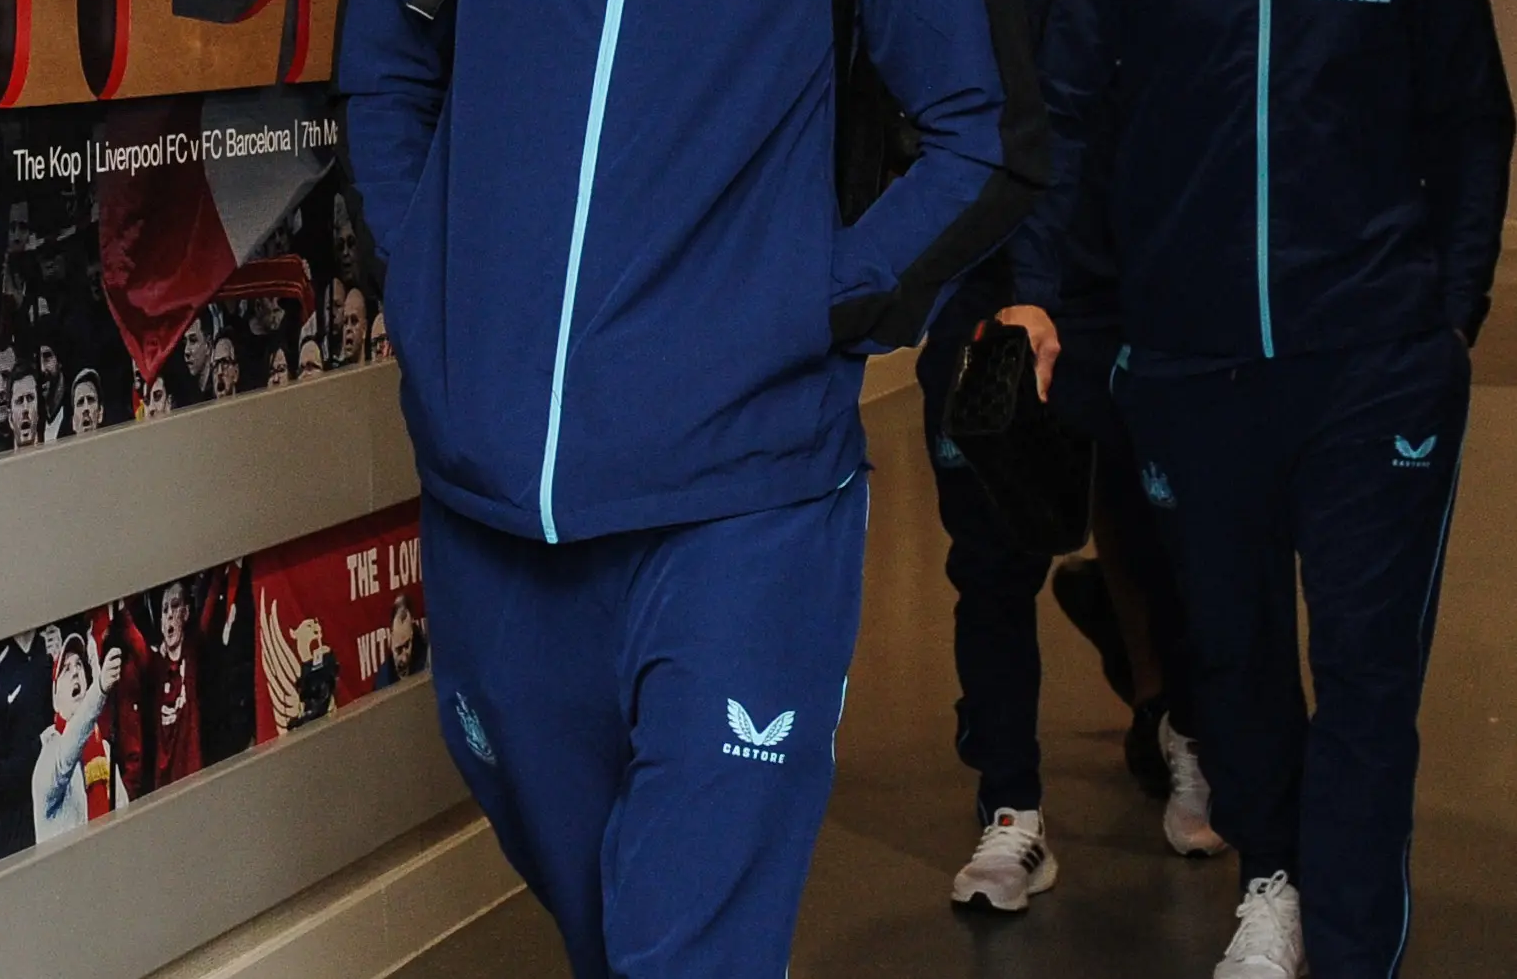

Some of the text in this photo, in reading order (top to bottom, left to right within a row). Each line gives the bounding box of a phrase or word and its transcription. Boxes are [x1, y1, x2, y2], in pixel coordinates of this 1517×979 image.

[13, 148, 45, 181] The
[49, 145, 82, 184] Kop
[95, 136, 163, 176] Liverpool
[166, 133, 188, 164] FC
[191, 140, 200, 162] v
[202, 129, 223, 161] FC
[226, 124, 292, 158] Barcelona
[301, 118, 322, 149] 7th
[346, 547, 380, 602] THE
[722, 742, 786, 764] CASTORE
